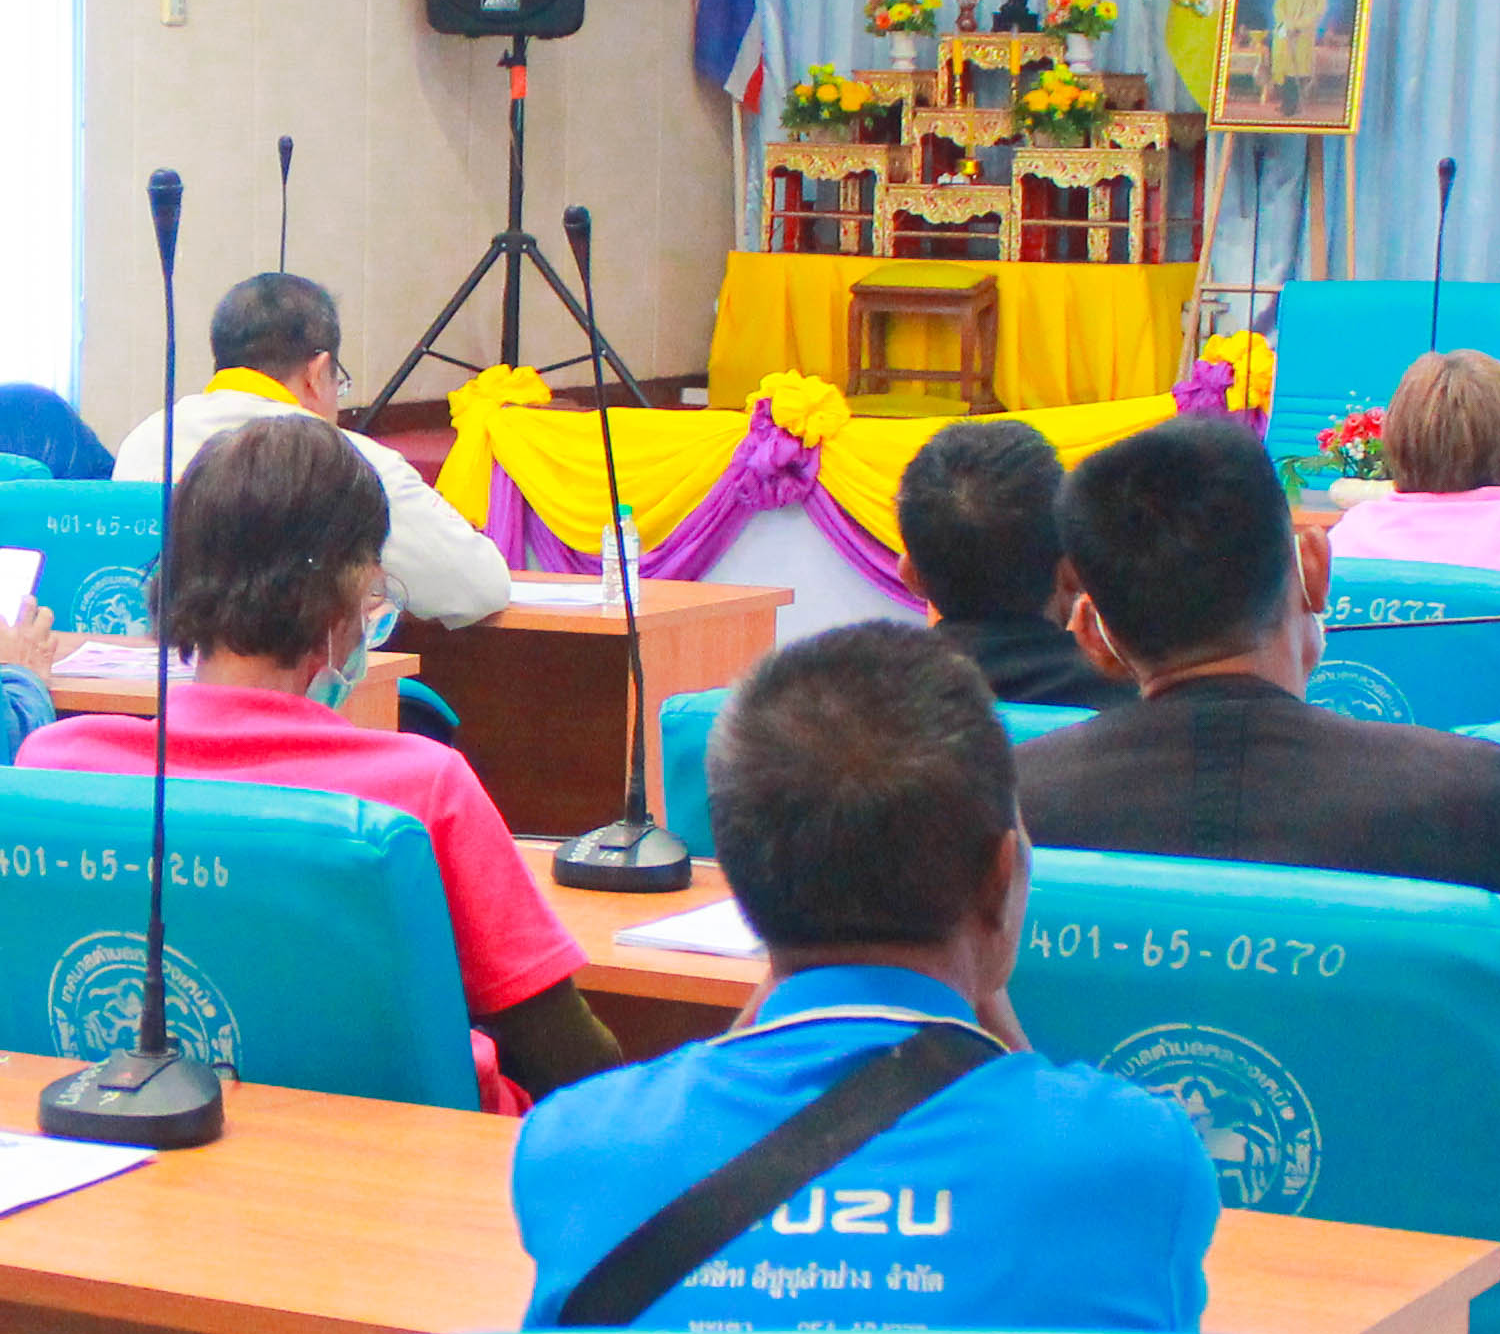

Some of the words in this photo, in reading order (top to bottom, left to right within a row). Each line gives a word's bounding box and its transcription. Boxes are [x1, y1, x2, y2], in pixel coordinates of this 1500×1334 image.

[46, 513, 161, 537] 401-65-02
[1028, 919, 1346, 978] 401-65-0270
[768, 1186, 953, 1237] UZU
